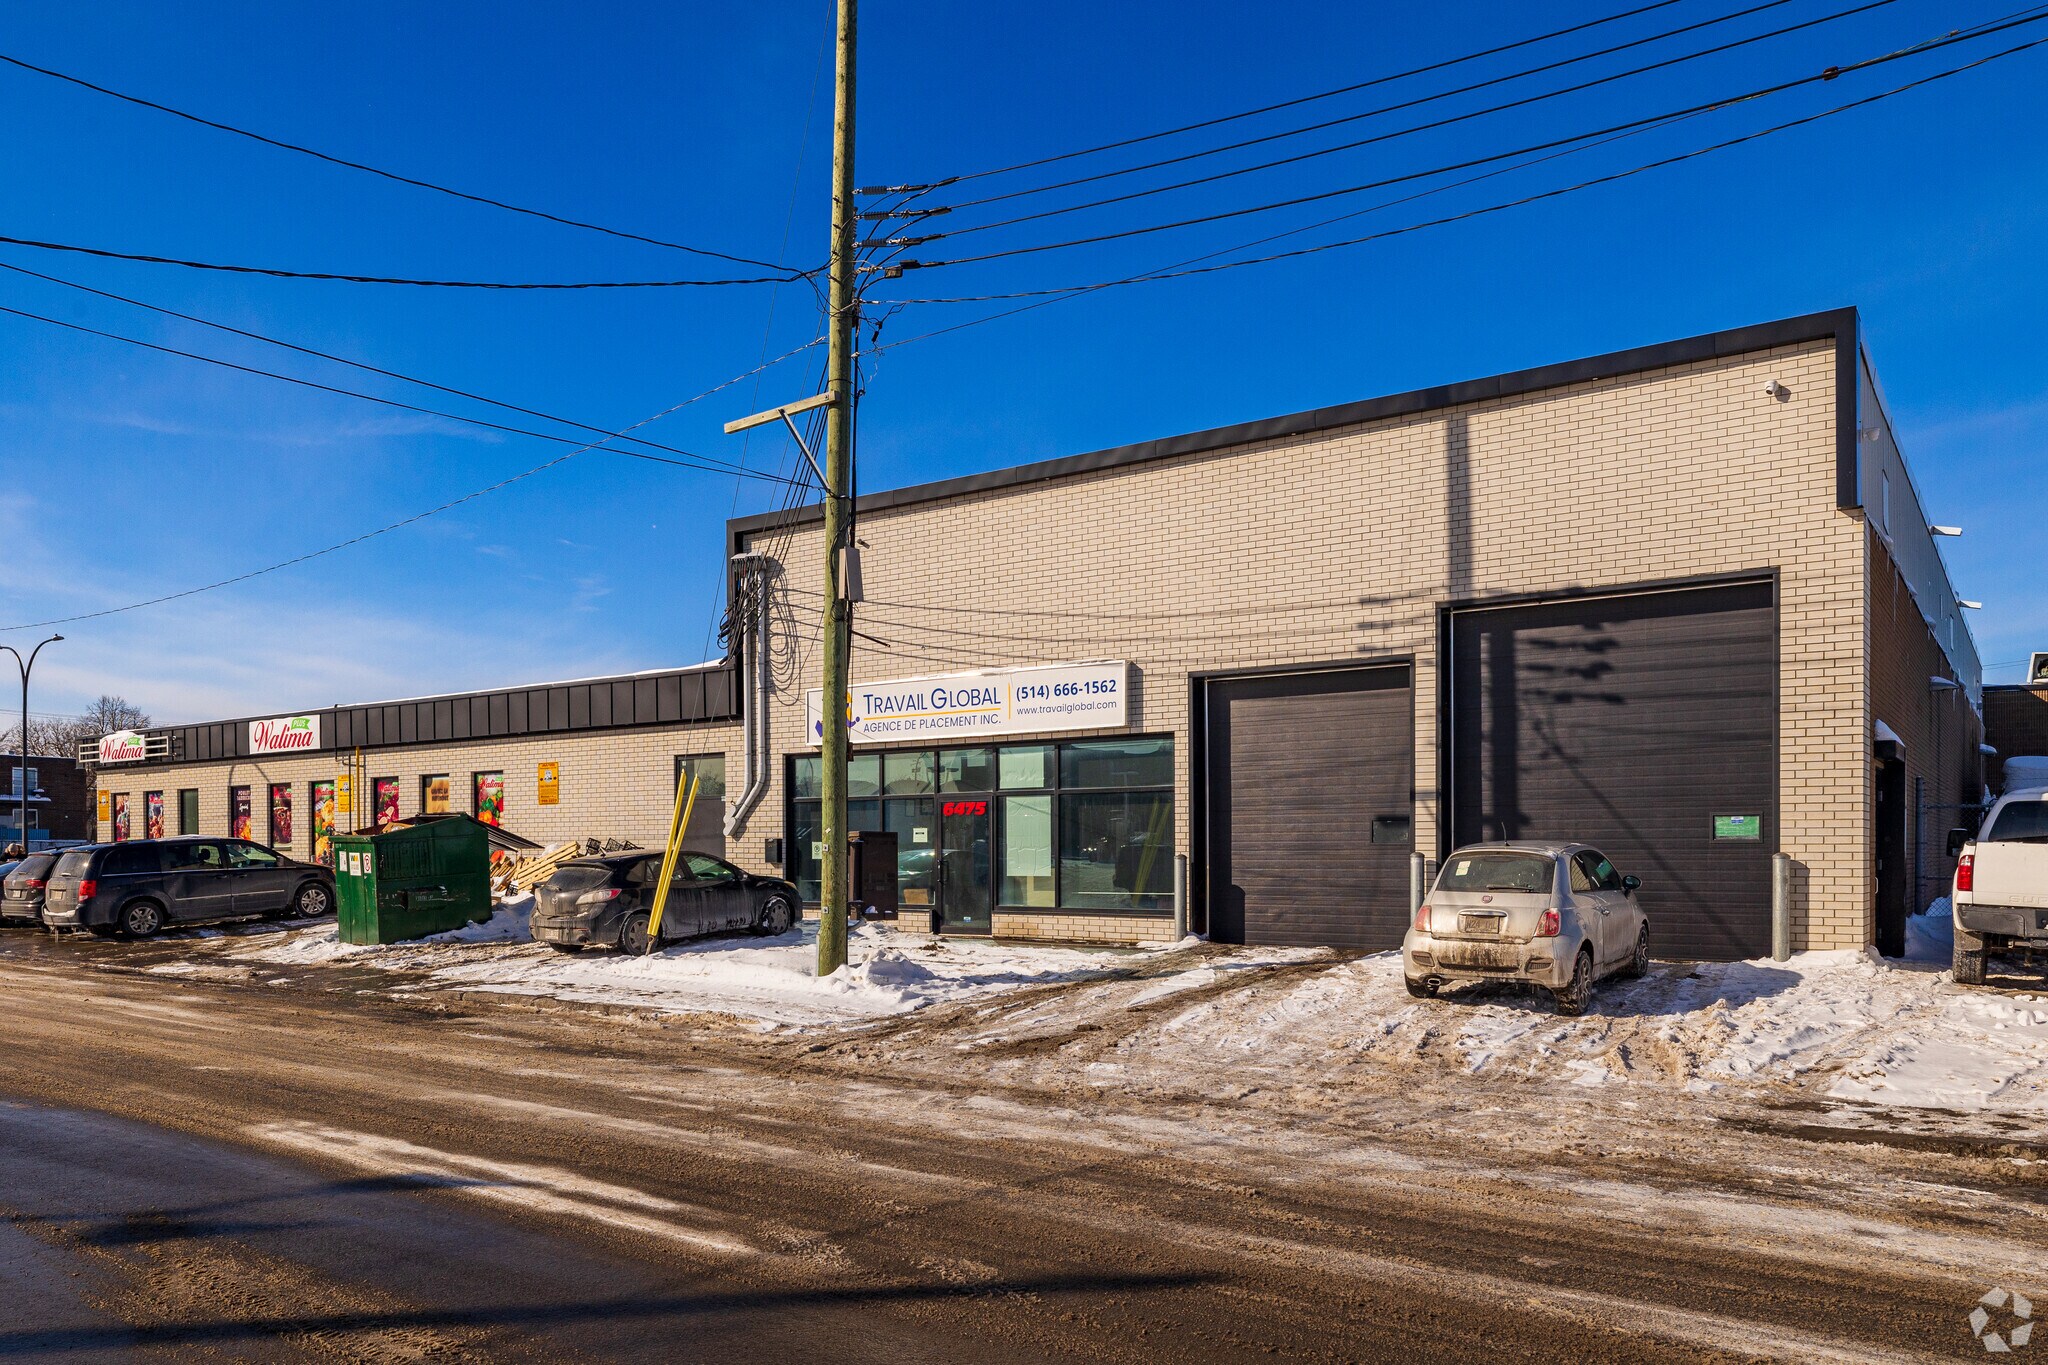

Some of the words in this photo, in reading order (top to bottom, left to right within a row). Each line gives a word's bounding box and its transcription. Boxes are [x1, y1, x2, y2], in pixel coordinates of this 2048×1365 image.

[863, 694, 928, 715] TRAVAIL
[931, 687, 1002, 709] GLOBAL
[1016, 685, 1050, 702] (514)
[1054, 679, 1117, 697] 666-1562
[1016, 701, 1117, 715] www.travailglobal.com
[292, 719, 306, 728] PLUS
[863, 720, 902, 733] AGENCE
[904, 719, 917, 731] DE
[919, 715, 978, 729] PLACEMENT
[980, 713, 1002, 725] INC.
[254, 720, 315, 752] Walima
[101, 739, 144, 762] Walima
[943, 801, 987, 817] 6475
